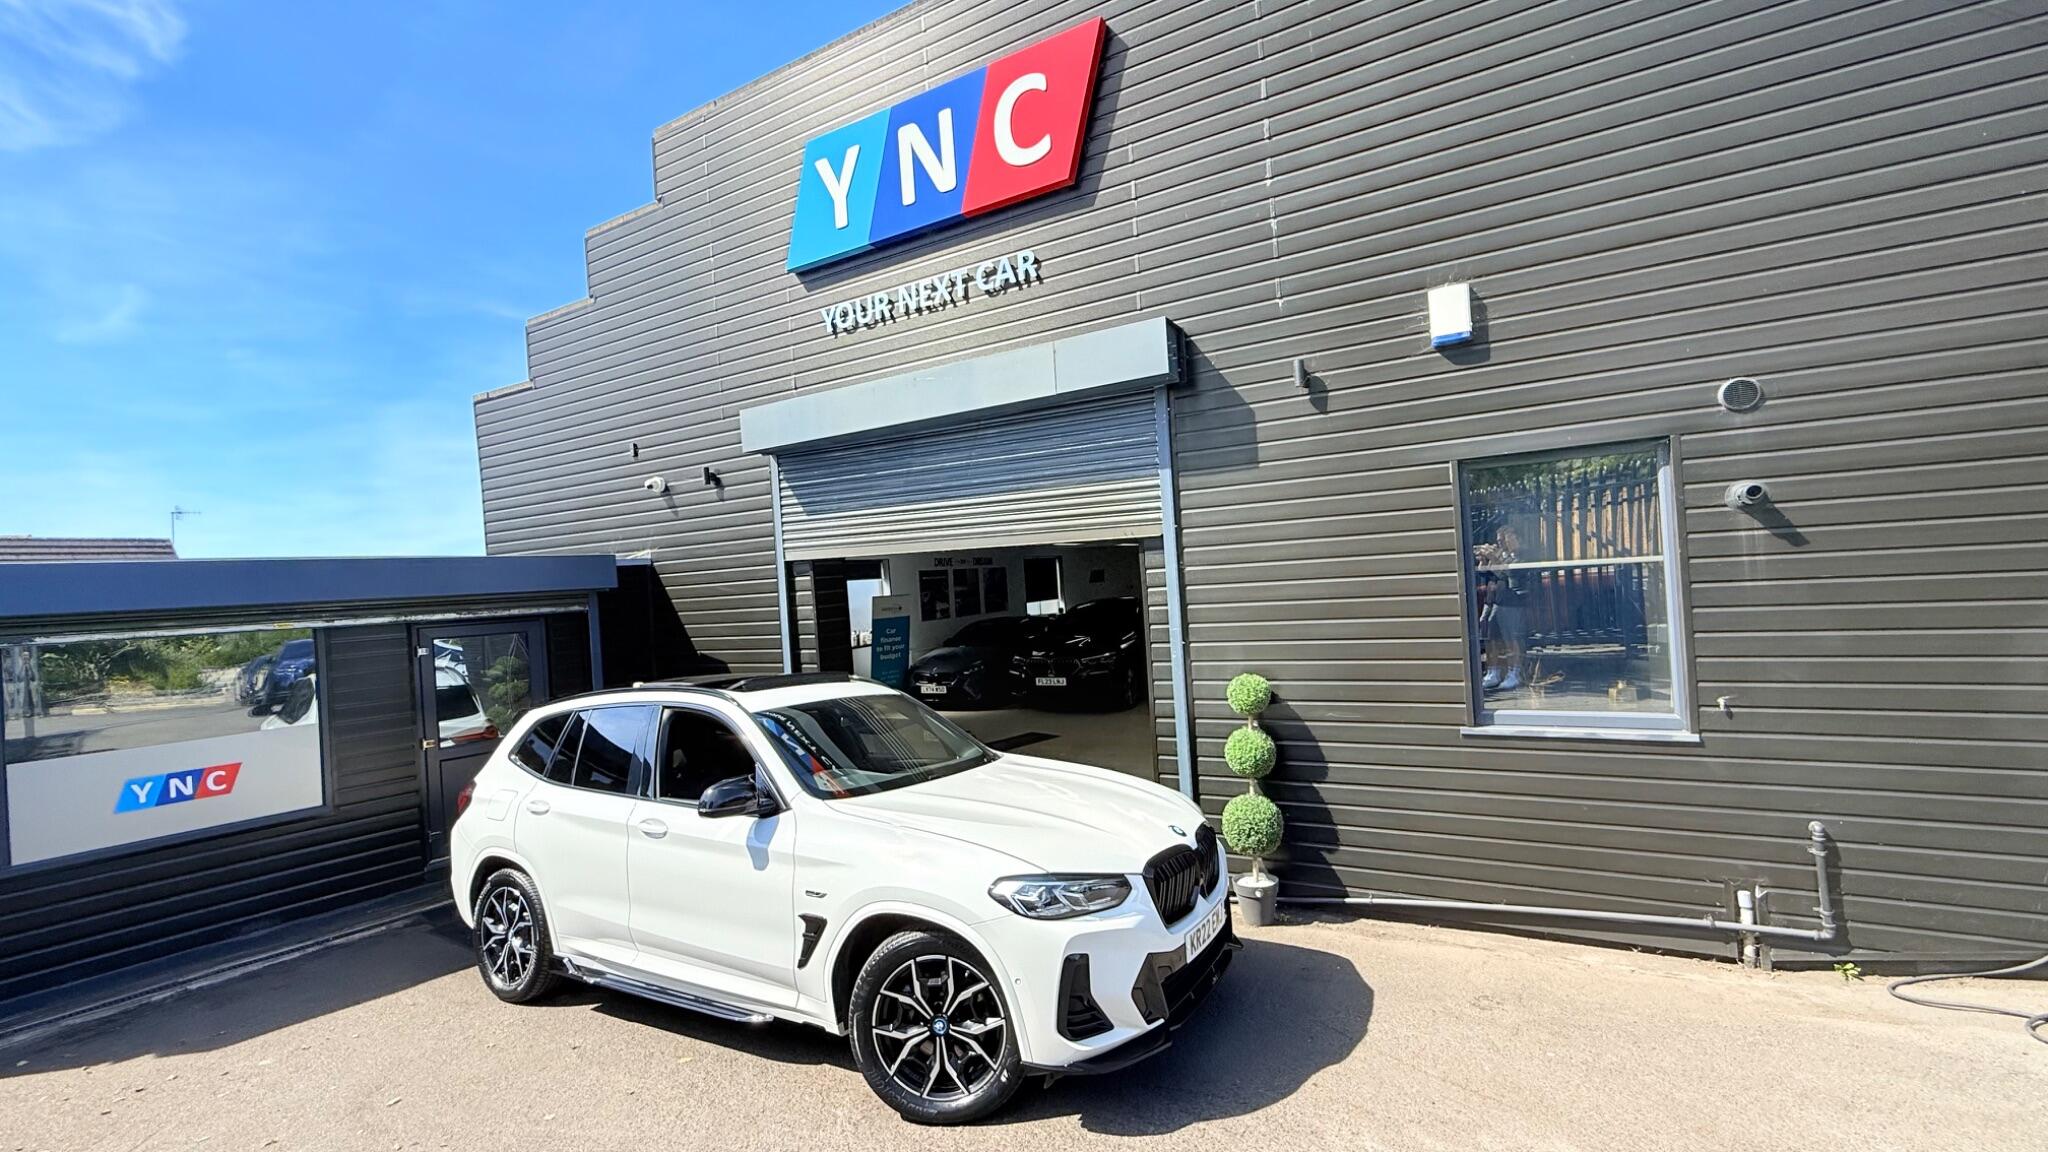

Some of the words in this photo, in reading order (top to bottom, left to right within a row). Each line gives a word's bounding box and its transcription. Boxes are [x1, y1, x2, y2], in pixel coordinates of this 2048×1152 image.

[814, 72, 1052, 230] YNC
[821, 293, 891, 333] YOUR
[898, 268, 968, 313] NEXT
[976, 249, 1038, 290] CAR
[934, 557, 954, 567] DRIVE
[880, 652, 902, 660] budget
[130, 770, 227, 804] YNC
[1189, 920, 1211, 955] KR22
